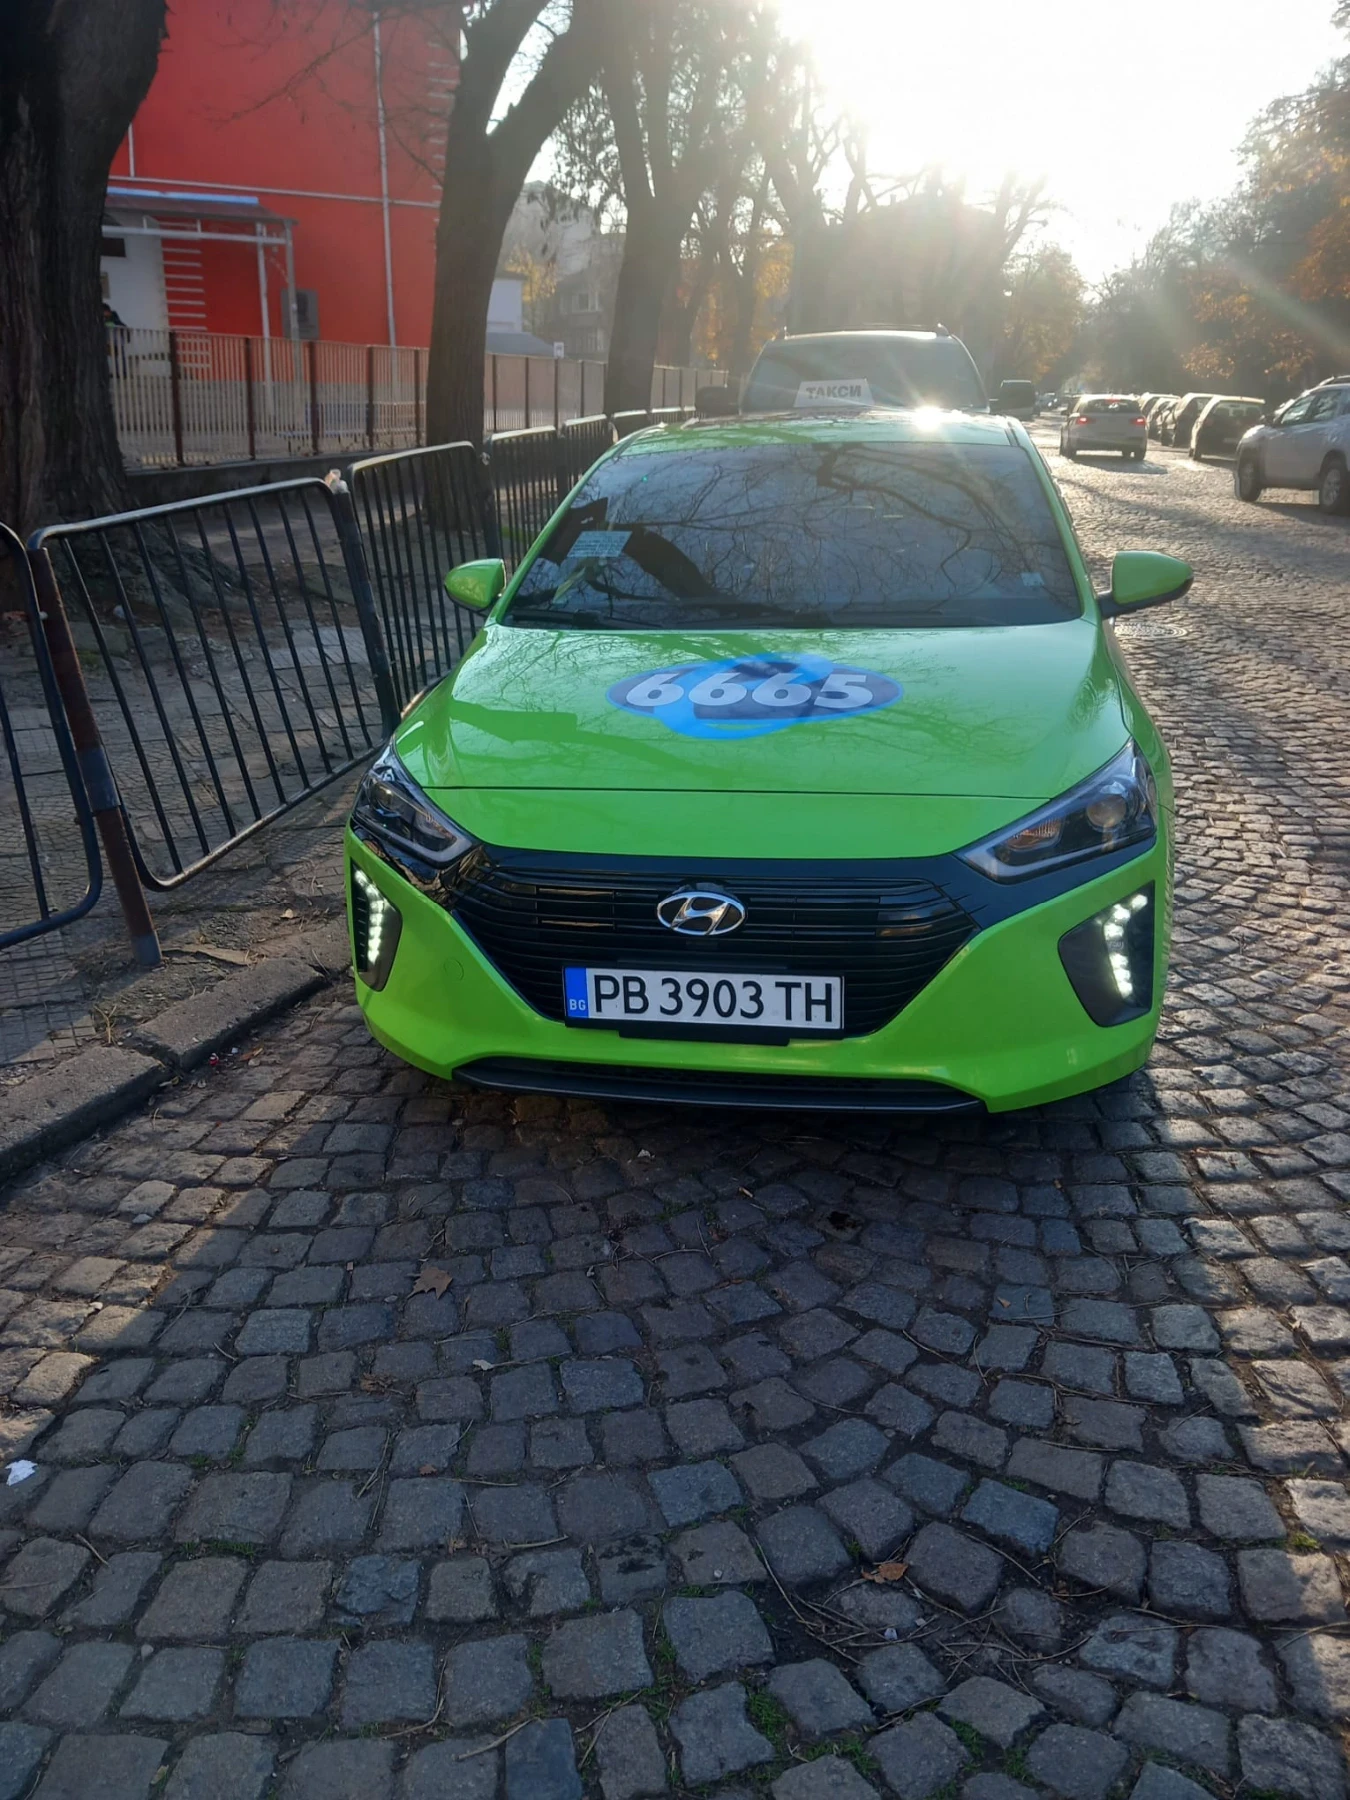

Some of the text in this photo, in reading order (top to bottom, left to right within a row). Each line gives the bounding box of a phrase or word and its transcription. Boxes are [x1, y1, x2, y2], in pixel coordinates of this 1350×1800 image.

[805, 385, 862, 399] ТАКСИ
[625, 672, 874, 709] 6665
[569, 999, 587, 1012] BG
[594, 974, 833, 1022] PB 3903 TH
